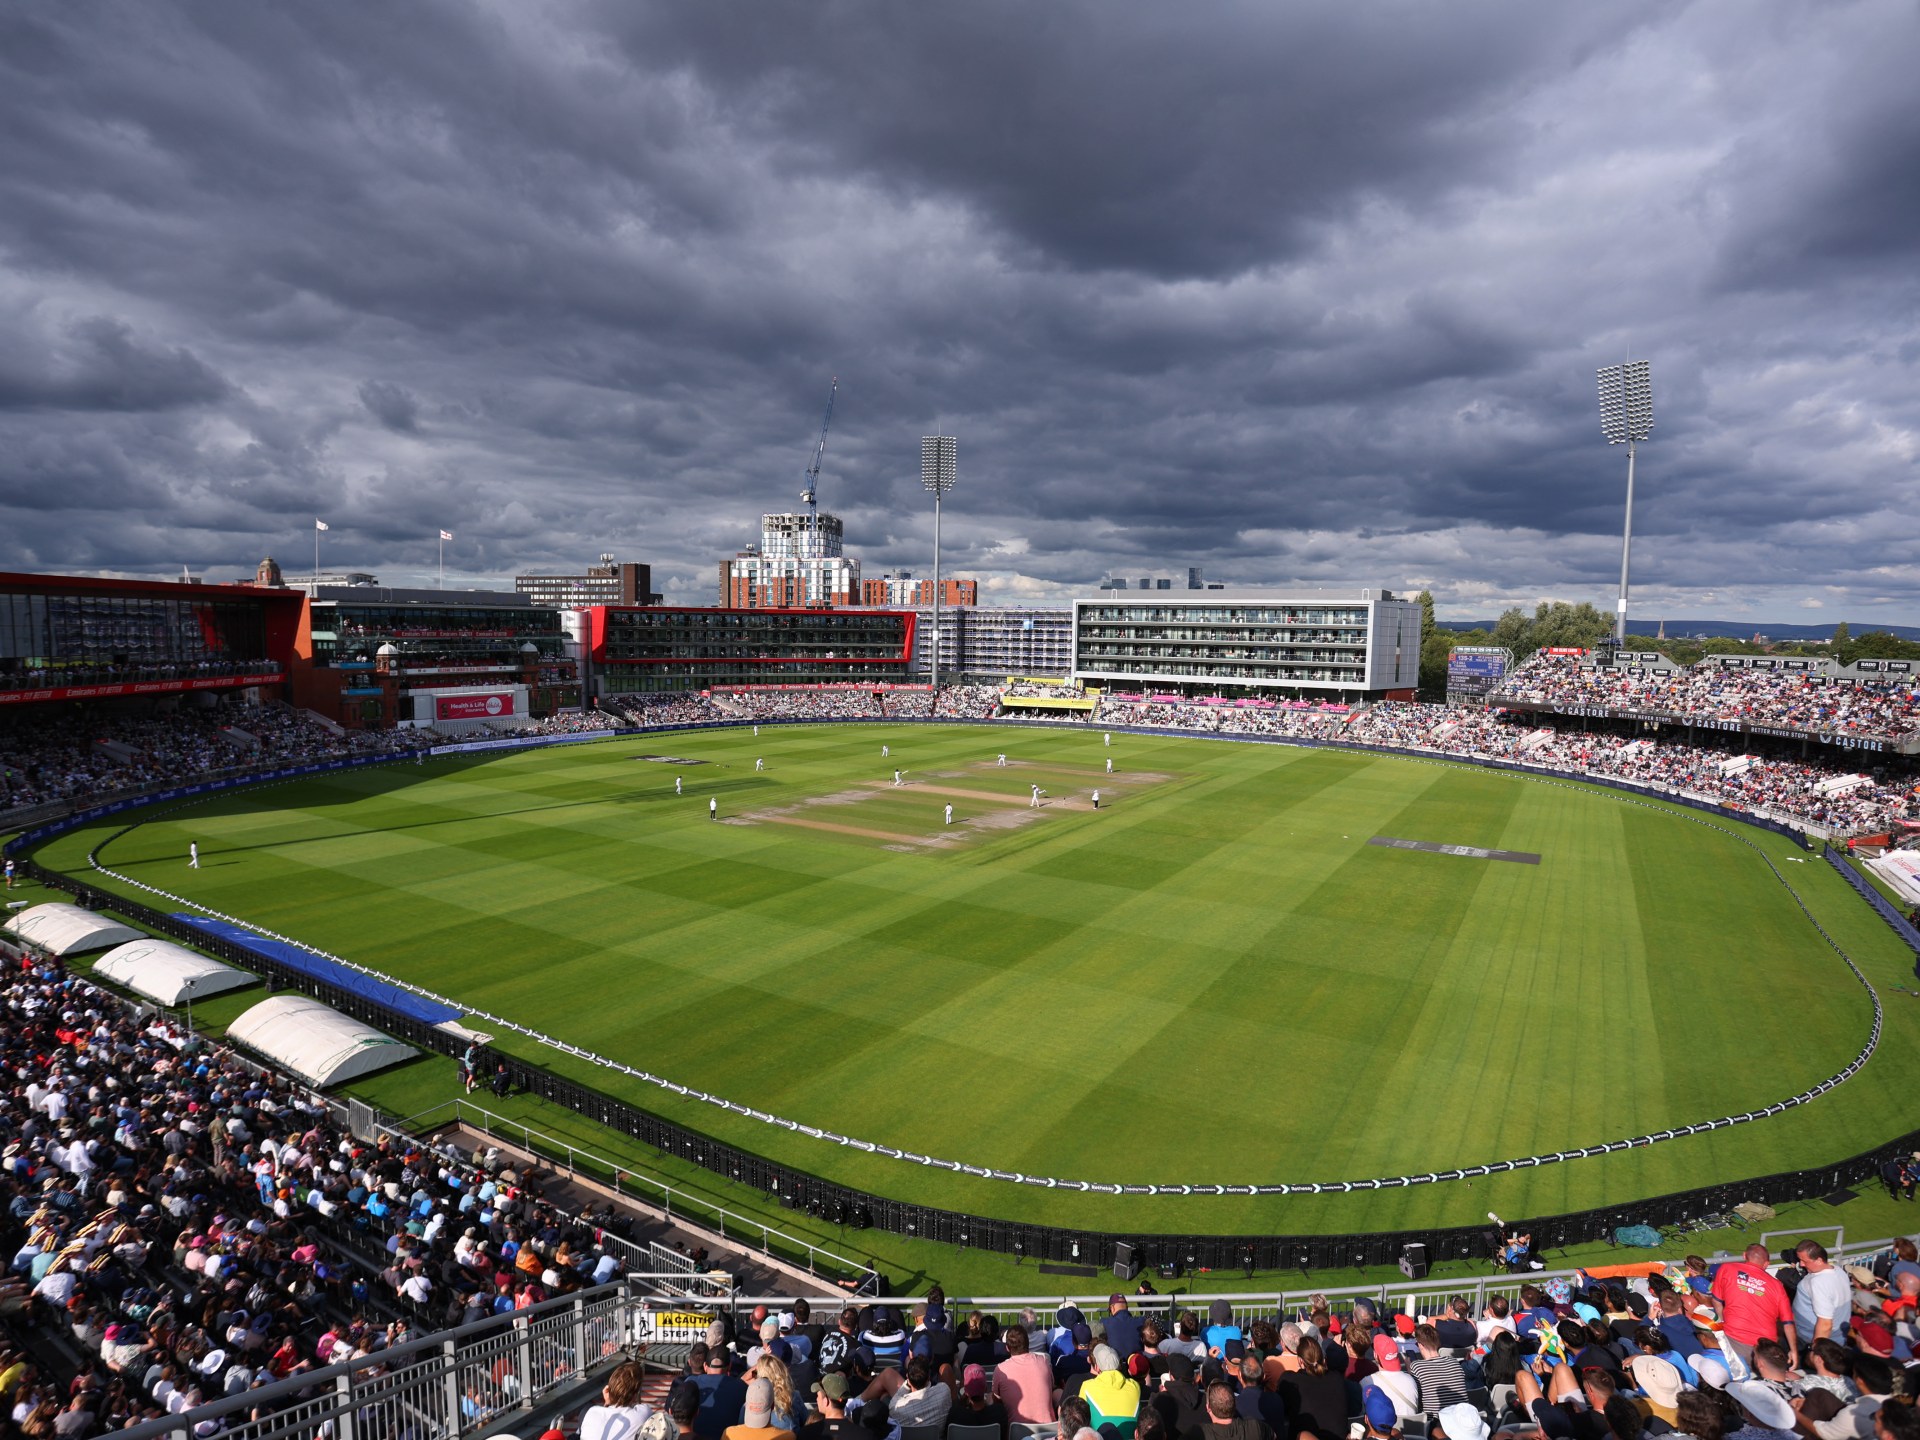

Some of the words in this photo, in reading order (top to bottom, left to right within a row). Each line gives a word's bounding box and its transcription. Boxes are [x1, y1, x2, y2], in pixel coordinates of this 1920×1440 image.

[1568, 707, 1609, 717] CASTORE
[1697, 720, 1741, 732] CASTORE
[1772, 729, 1789, 737] NEVER
[1791, 731, 1808, 739] STOPS
[1836, 736, 1883, 752] CASTORE
